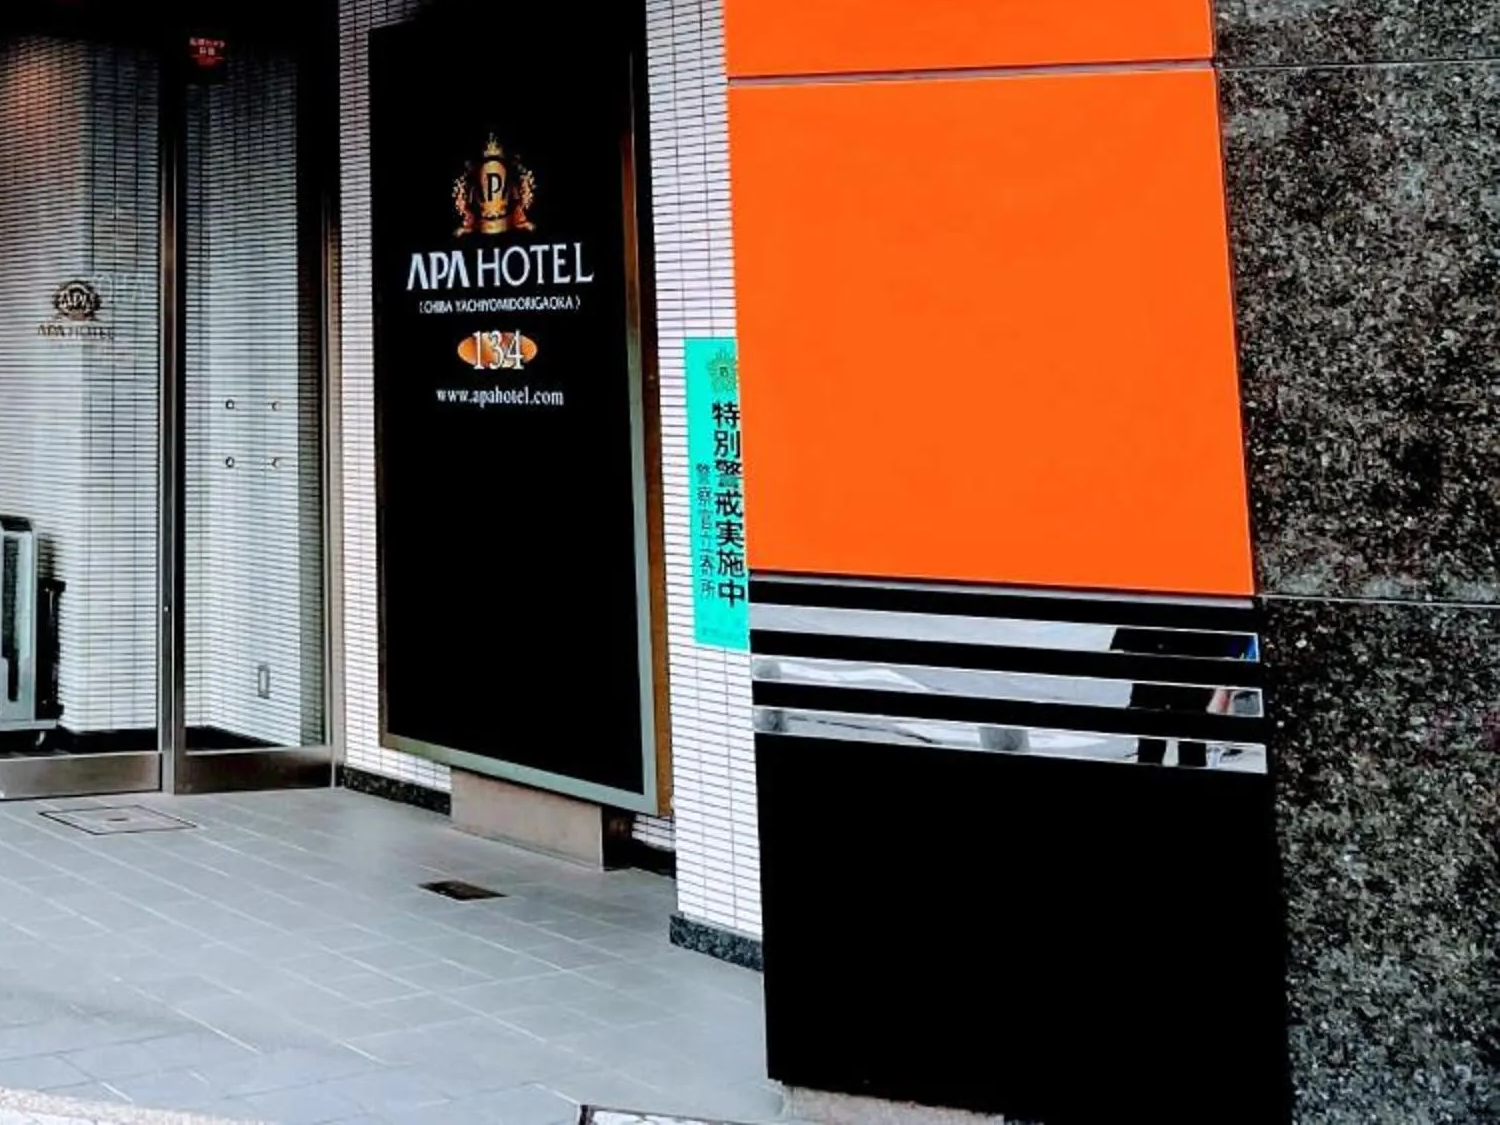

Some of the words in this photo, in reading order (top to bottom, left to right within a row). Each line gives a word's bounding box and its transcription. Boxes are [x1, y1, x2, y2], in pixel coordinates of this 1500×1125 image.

[406, 249, 471, 291] APA
[477, 241, 595, 288] HOTEL
[473, 329, 525, 370] 134
[436, 385, 564, 408] www.apahotel.com
[712, 401, 746, 608] 特別警戒実施中
